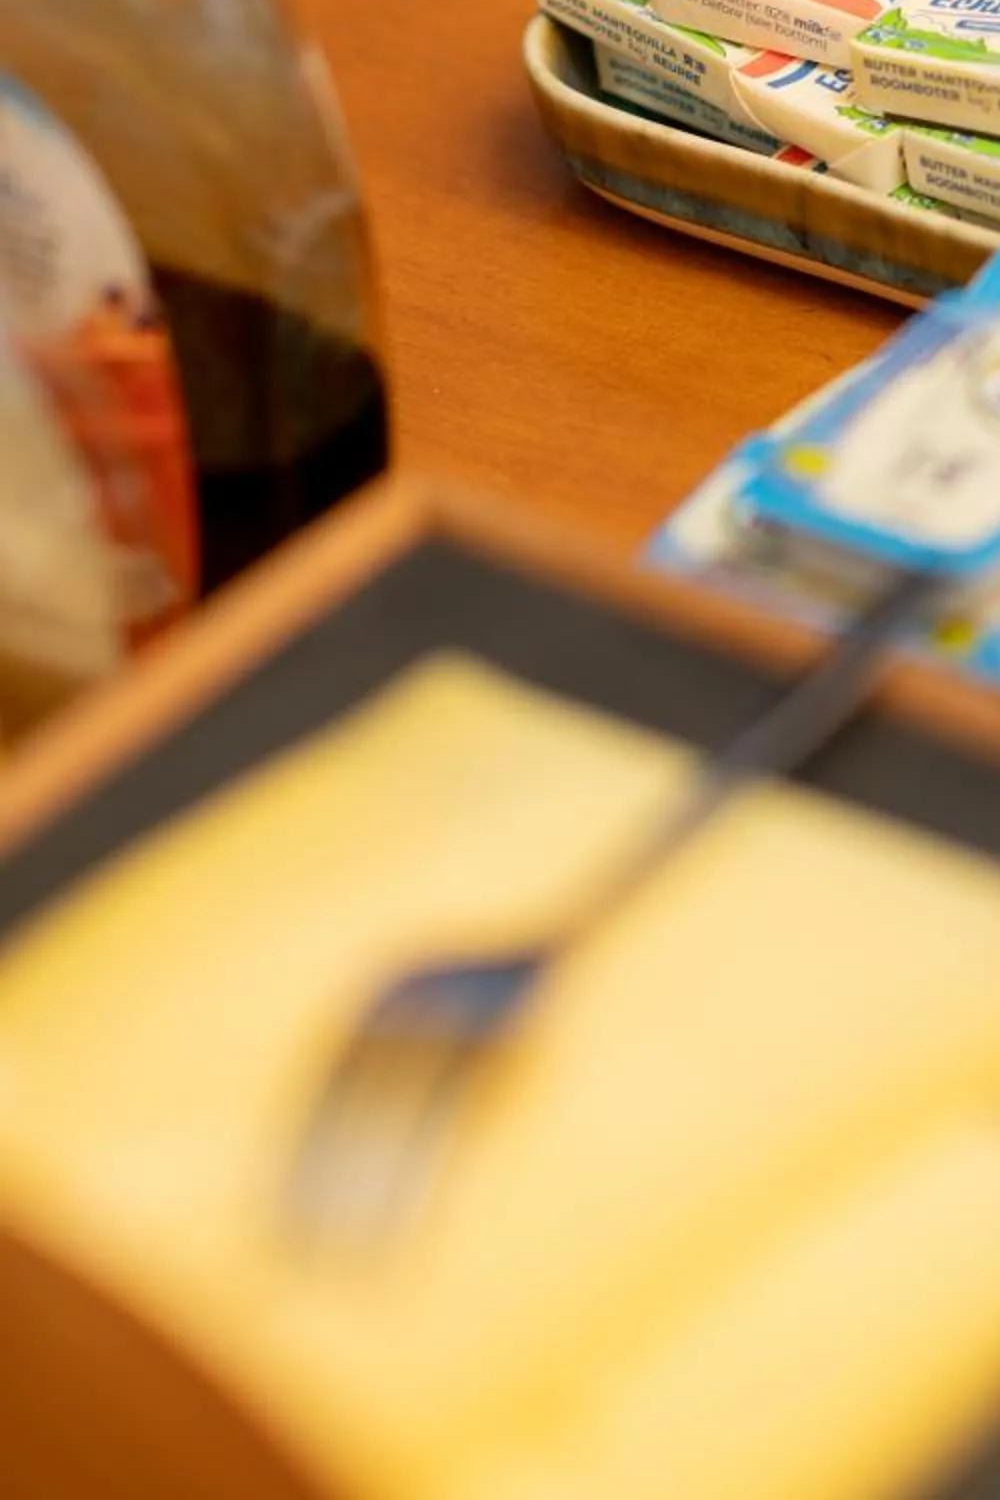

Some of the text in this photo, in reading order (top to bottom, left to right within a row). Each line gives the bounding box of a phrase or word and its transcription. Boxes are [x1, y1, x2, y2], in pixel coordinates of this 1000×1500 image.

[863, 57, 919, 79] BUTTER
[869, 73, 961, 103] ROOMBOTER
[918, 155, 969, 181] BUTTER
